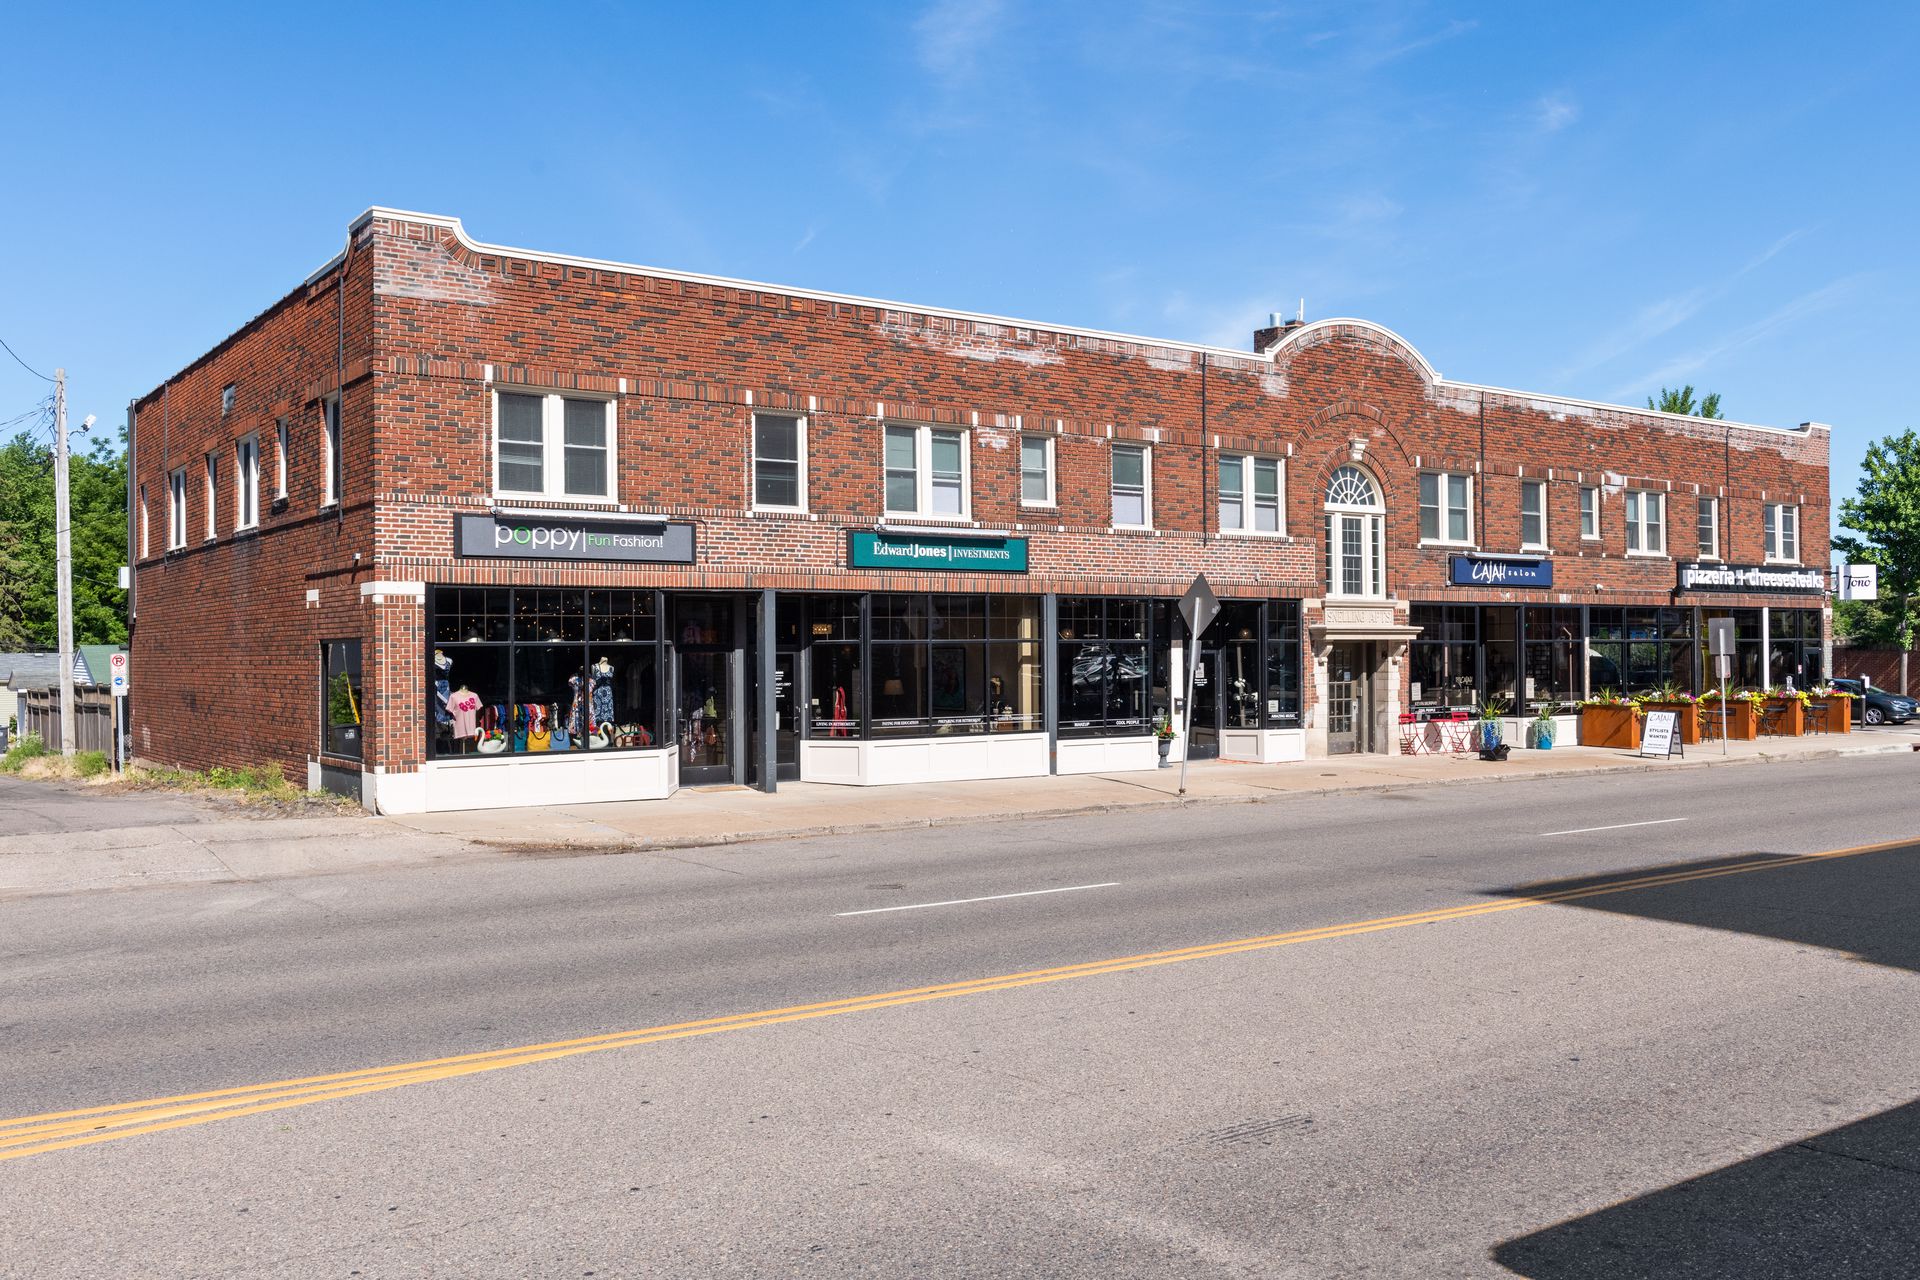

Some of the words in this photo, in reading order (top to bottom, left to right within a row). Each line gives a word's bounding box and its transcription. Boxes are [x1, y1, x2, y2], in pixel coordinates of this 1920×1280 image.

[495, 526, 581, 550] poppy
[588, 535, 611, 547] Fun
[613, 535, 664, 549] Fashion!
[953, 549, 1010, 560] INVESTMENTS
[1472, 561, 1506, 584] CAJAH
[1508, 569, 1537, 577] salon
[1684, 564, 1735, 588] pizzeria
[1746, 568, 1825, 588] cheesesteaks
[1843, 575, 1872, 590] Tono
[1327, 611, 1365, 624] SNELLING
